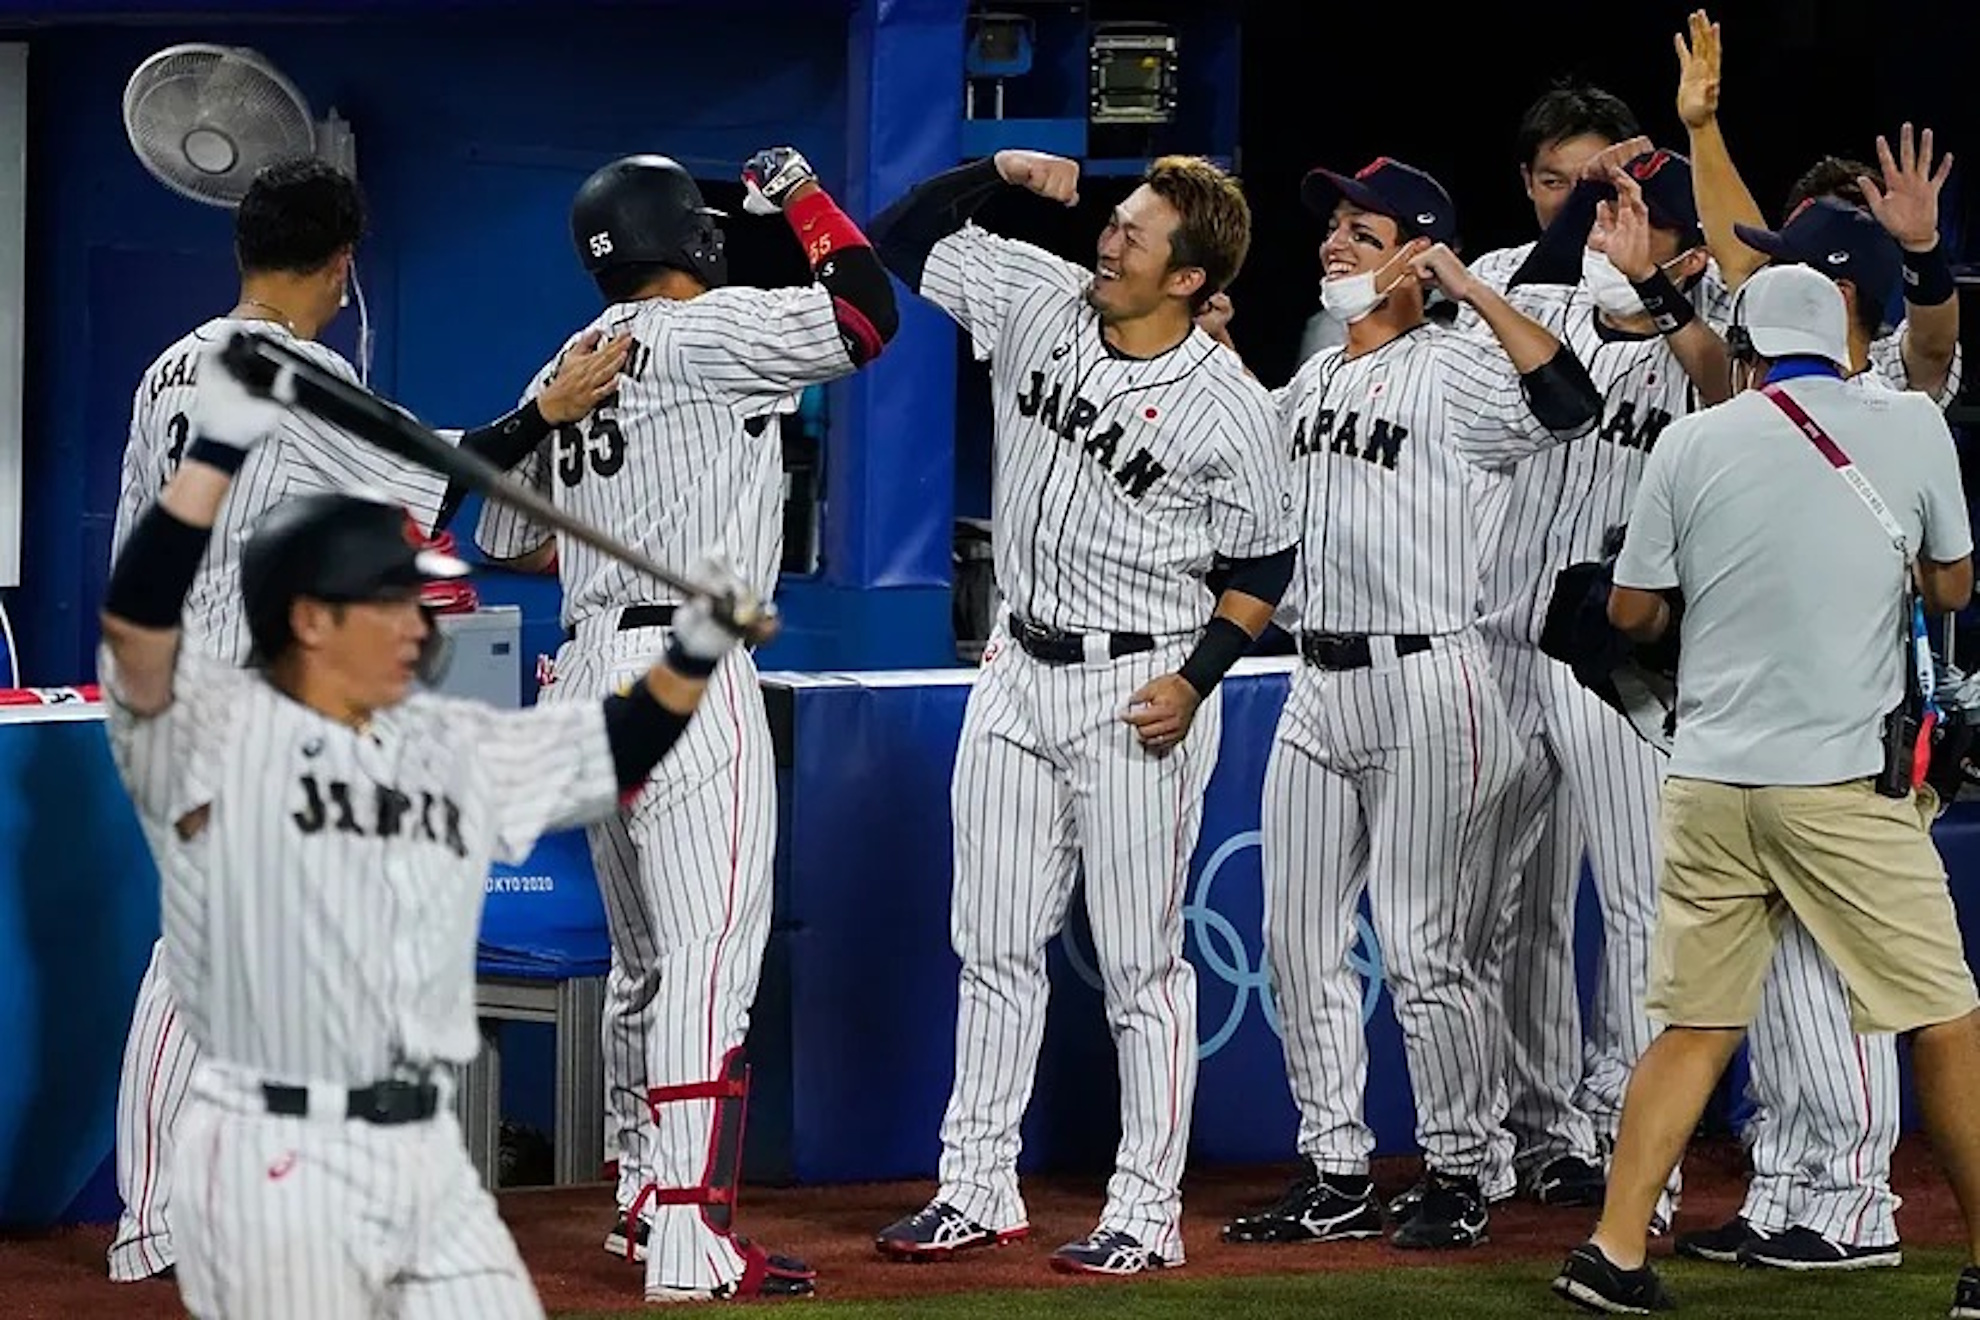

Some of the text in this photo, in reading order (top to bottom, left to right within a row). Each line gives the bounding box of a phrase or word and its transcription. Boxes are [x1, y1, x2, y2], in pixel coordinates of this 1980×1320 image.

[589, 231, 613, 257] 55
[810, 233, 832, 265] 55
[559, 391, 625, 488] 55
[1018, 371, 1167, 499] JAPAN
[1290, 409, 1408, 471] APAN
